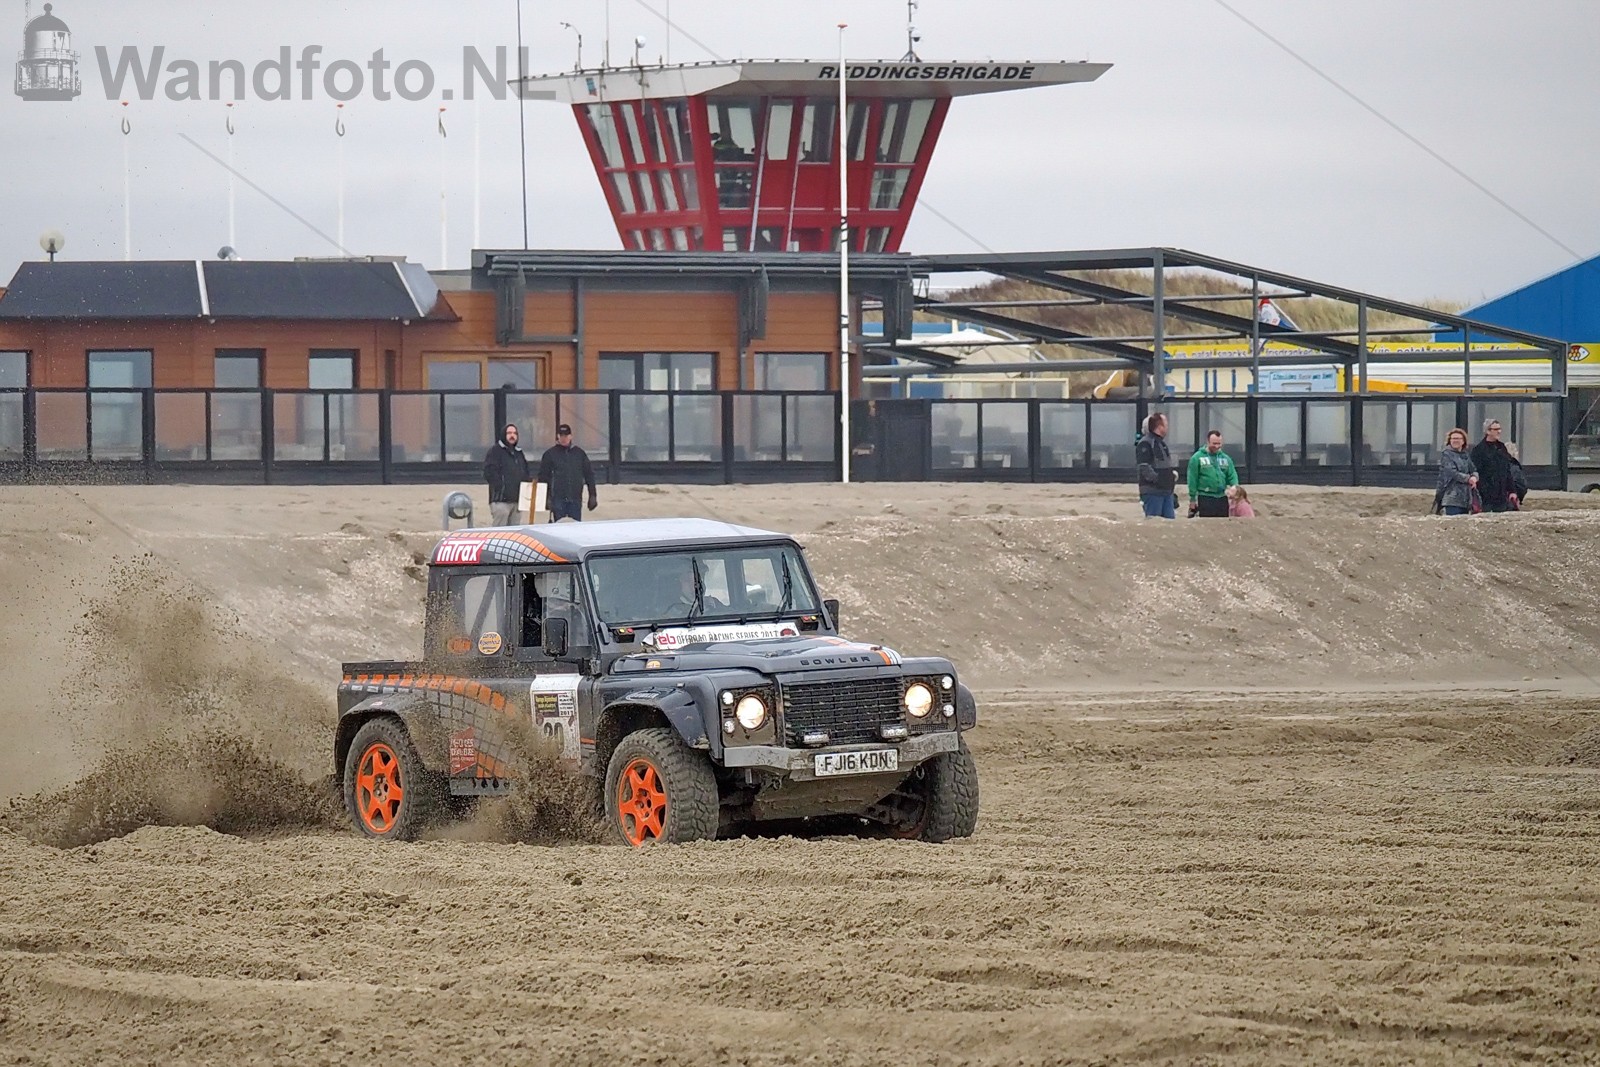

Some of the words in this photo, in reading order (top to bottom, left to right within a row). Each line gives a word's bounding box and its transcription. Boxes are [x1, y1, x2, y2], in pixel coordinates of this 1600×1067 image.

[818, 66, 1035, 79] REDDINGSBRIGADE
[800, 656, 871, 666] BOWLER
[824, 754, 855, 771] FJ16
[860, 752, 889, 769] KDN
